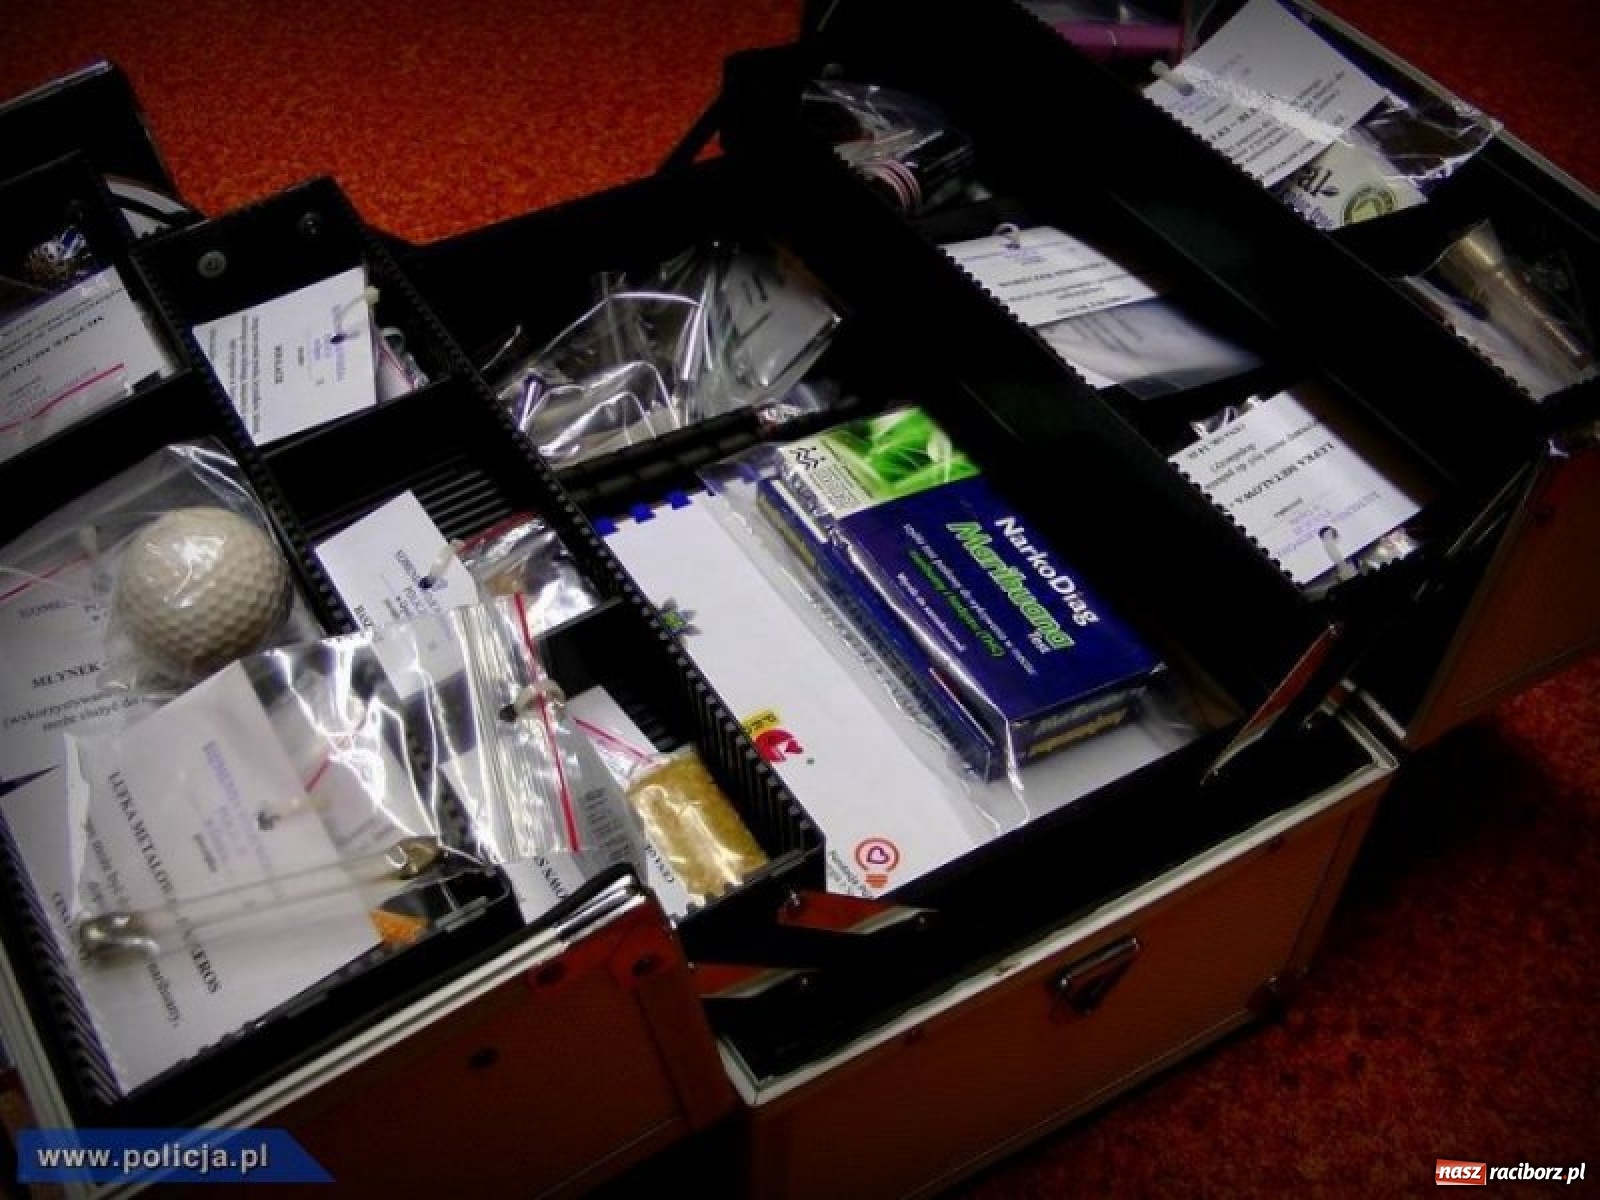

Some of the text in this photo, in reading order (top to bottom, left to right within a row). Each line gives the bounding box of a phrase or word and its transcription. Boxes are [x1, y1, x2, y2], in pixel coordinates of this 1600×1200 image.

[945, 521, 1075, 650] Marihuana
[994, 515, 1101, 627] NarkoDiag
[130, 819, 178, 912] METALOW
